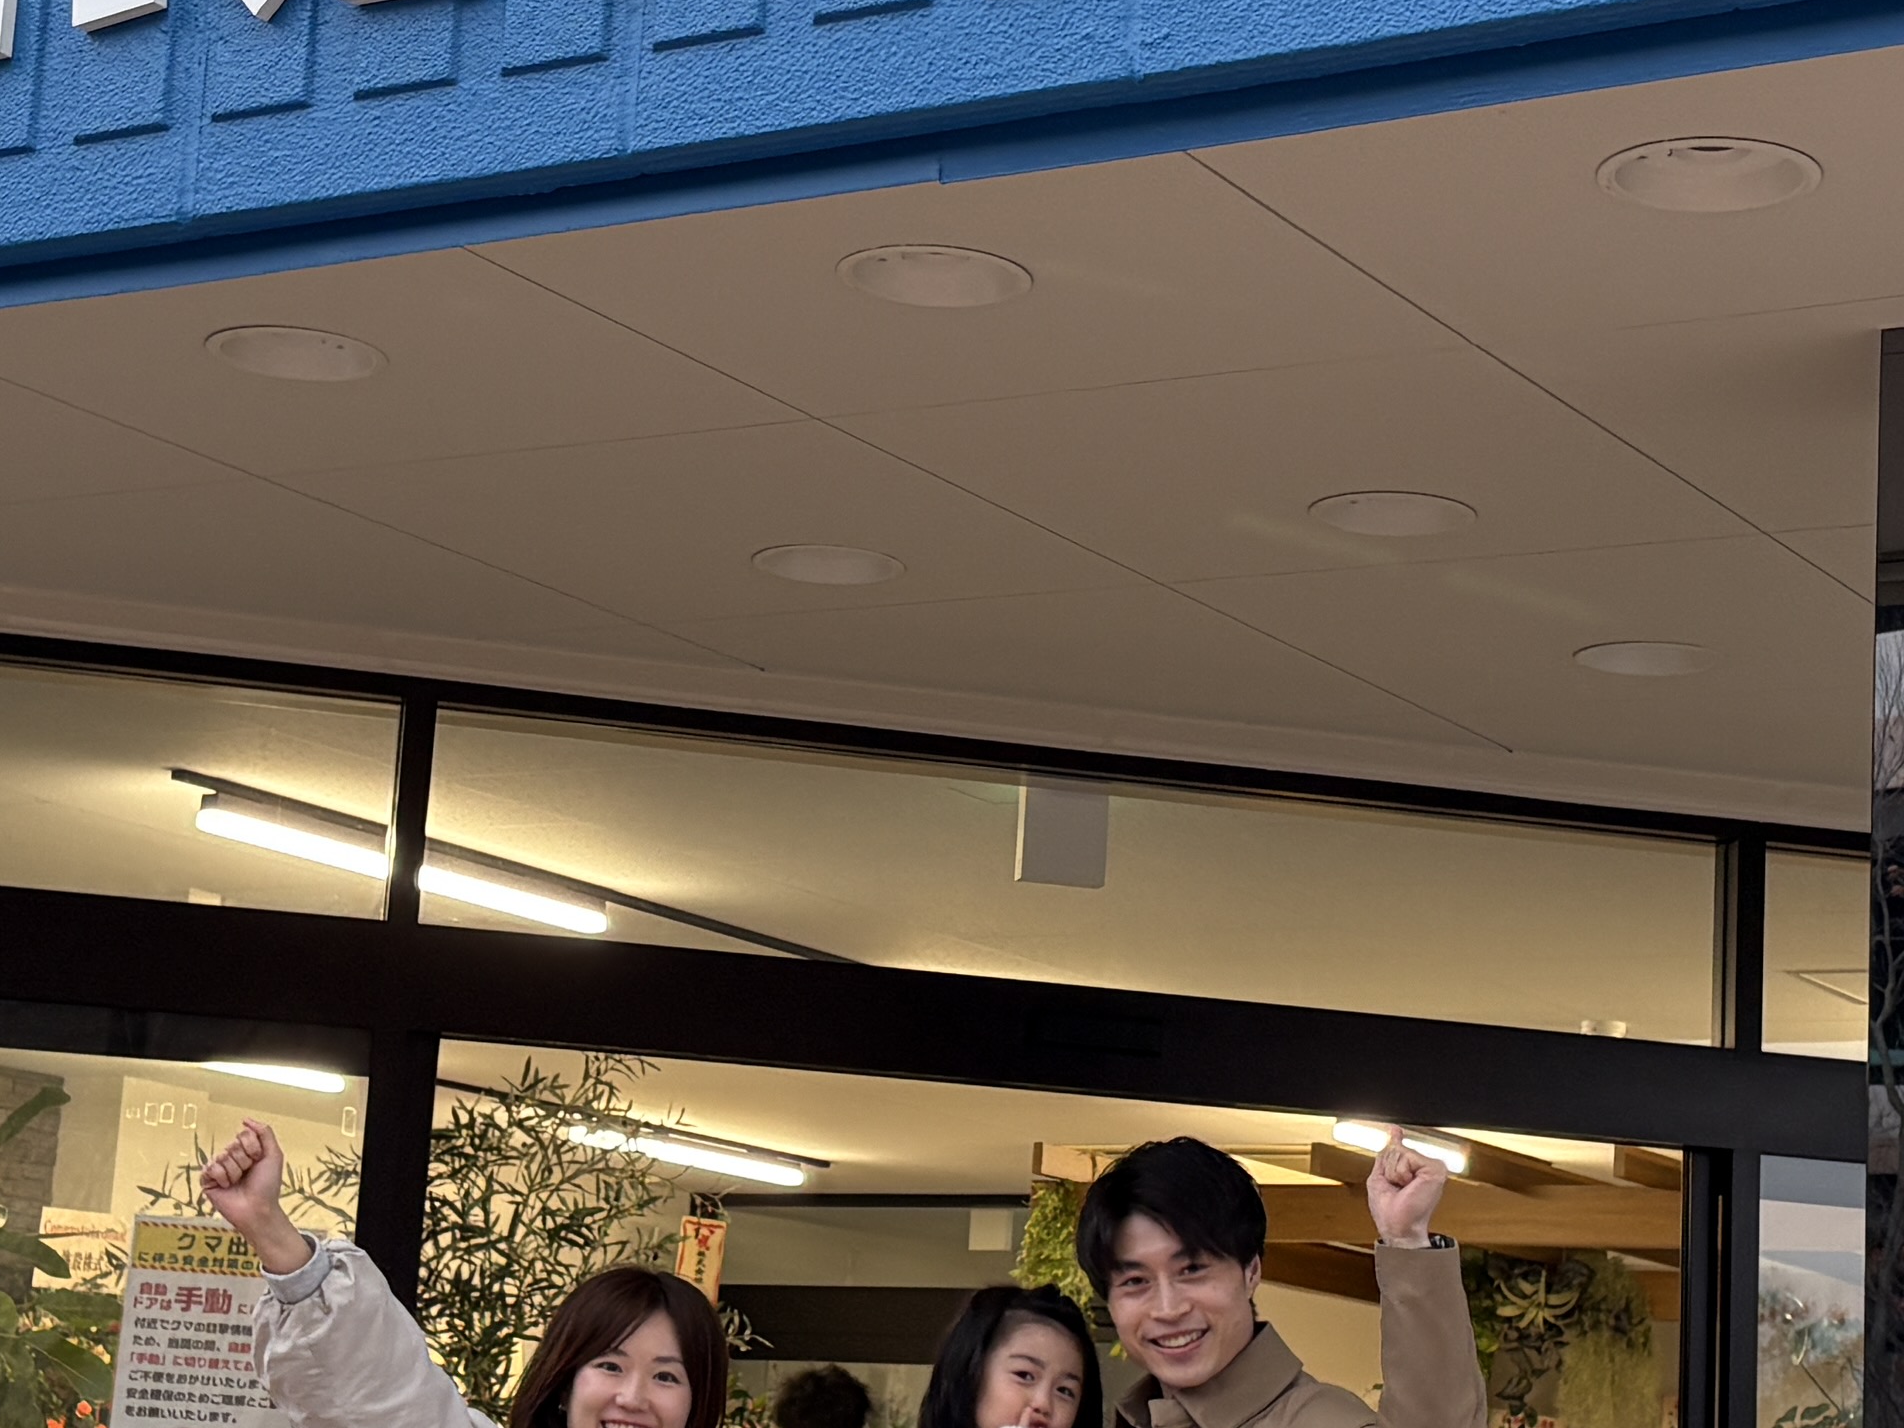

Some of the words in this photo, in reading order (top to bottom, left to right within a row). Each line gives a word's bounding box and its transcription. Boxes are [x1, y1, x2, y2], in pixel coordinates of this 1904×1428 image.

[177, 1232, 259, 1257] クマ出
[174, 1286, 233, 1315] 手動
[126, 1387, 278, 1410] 安全確保のためご理解とご
